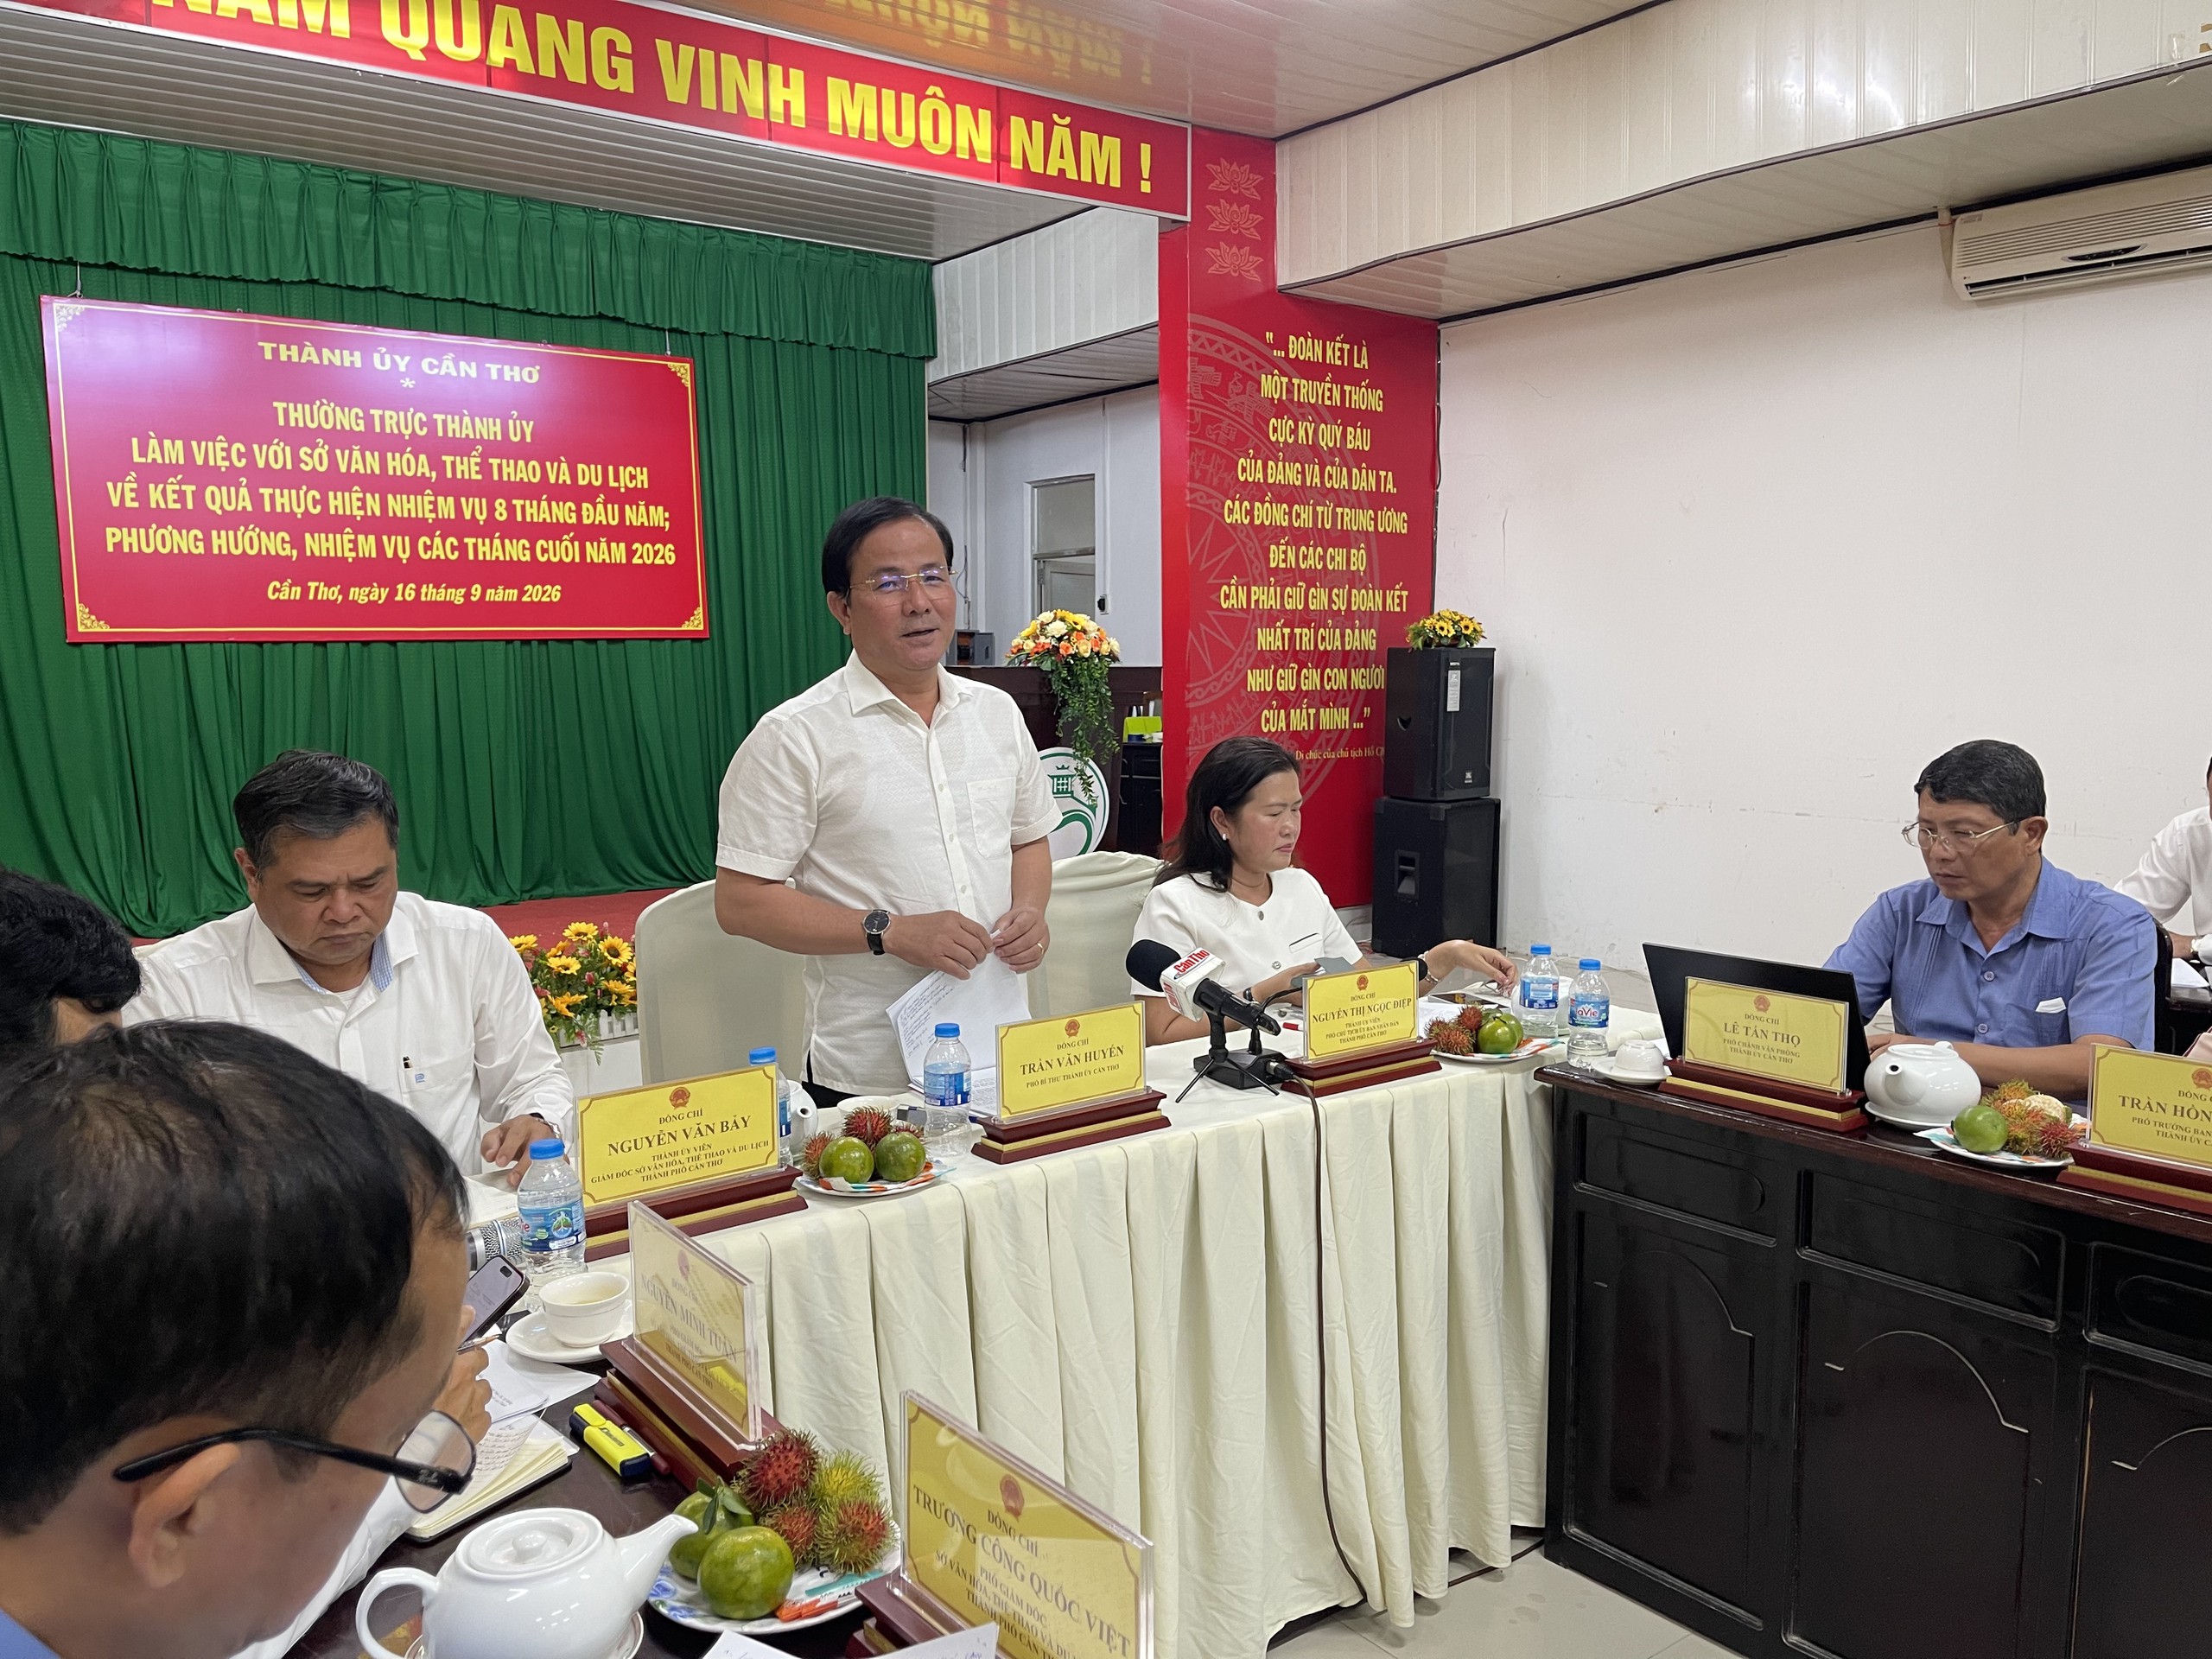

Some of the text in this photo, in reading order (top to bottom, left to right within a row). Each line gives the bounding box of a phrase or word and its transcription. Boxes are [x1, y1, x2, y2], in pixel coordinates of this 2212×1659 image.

[380, 0, 633, 93] QUANG
[656, 39, 805, 128] VINH
[827, 76, 992, 163] MUÔN
[1010, 114, 1121, 188] NĂM
[258, 342, 540, 383] THÀNH ỦY CẦN THƠ
[1289, 332, 1322, 362] ĐOÀN
[1326, 334, 1350, 365] KẾT
[1354, 340, 1368, 369] LÀ
[1262, 370, 1382, 412] MỘT TRUYỀN THỐNG
[273, 400, 534, 442] THƯỜNG TRỰC THÀNH ỦY
[1269, 416, 1370, 451] CỰC KỲ QUÝ BÁU
[132, 431, 648, 493] LÀM VIỆC VỚI SỞ VĂN HÓA, THỂ THAO VÀ DU LỊCH
[1238, 449, 1396, 493] CỦA ĐẢNG VÀ CỦA DÂN TA.
[108, 471, 669, 531] VỀ KẾT QUẢ THỰC HIỆN NHIỆM VỤ 8 THÁNG ĐẦU NĂM;
[1224, 493, 1407, 533] CÁC ĐỒNG CHÍ TỪ TRUNG ƯƠNG
[105, 524, 676, 564] PHƯƠNG HƯỚNG, NHIỆM VỤ CÁC THÁNG CUỐI NĂM 2026
[1269, 537, 1366, 575] ĐẾN CÁC CHI BỘ
[268, 580, 561, 604] Cần Thơ, ngày 16 tháng 9 năm 2026
[1220, 575, 1408, 615] CẦN PHẢI GIỮ GÌN SỰ ĐOÀN KẾT
[1257, 619, 1376, 651] NHẤT TRÍ CỦA ĐẢNG
[1248, 664, 1274, 691] NHƯ
[1277, 664, 1298, 691] GIỮ
[1300, 663, 1320, 690] GÌN
[1324, 668, 1347, 690] CON
[1262, 701, 1286, 732] CỦA
[1290, 699, 1315, 731] MẮT
[1320, 702, 1349, 729] MÌNH
[1351, 1007, 1364, 1016] THỊ
[1367, 1001, 1391, 1014] NGỌC
[1724, 1021, 1739, 1034] LÊ
[1772, 1032, 1801, 1047] THỌ
[1057, 1053, 1081, 1067] VĂN
[658, 1108, 703, 1125] ĐỒNG CHÍ
[607, 1115, 752, 1156] NGUYỄN VĂN BẢY
[694, 1143, 712, 1154] VIÊN
[648, 1161, 664, 1172] VĂN
[703, 1150, 725, 1161] THAO
[727, 1147, 736, 1156] VÀ
[738, 1145, 749, 1154] DU
[751, 1141, 769, 1153] LỊCH
[707, 1158, 723, 1168] THƠ
[988, 1510, 1038, 1556] ĐỒNG CHÍ
[913, 1484, 1130, 1657] TRƯƠNG CÔNG QUỐC VIỆT
[980, 1567, 998, 1586] PHÓ
